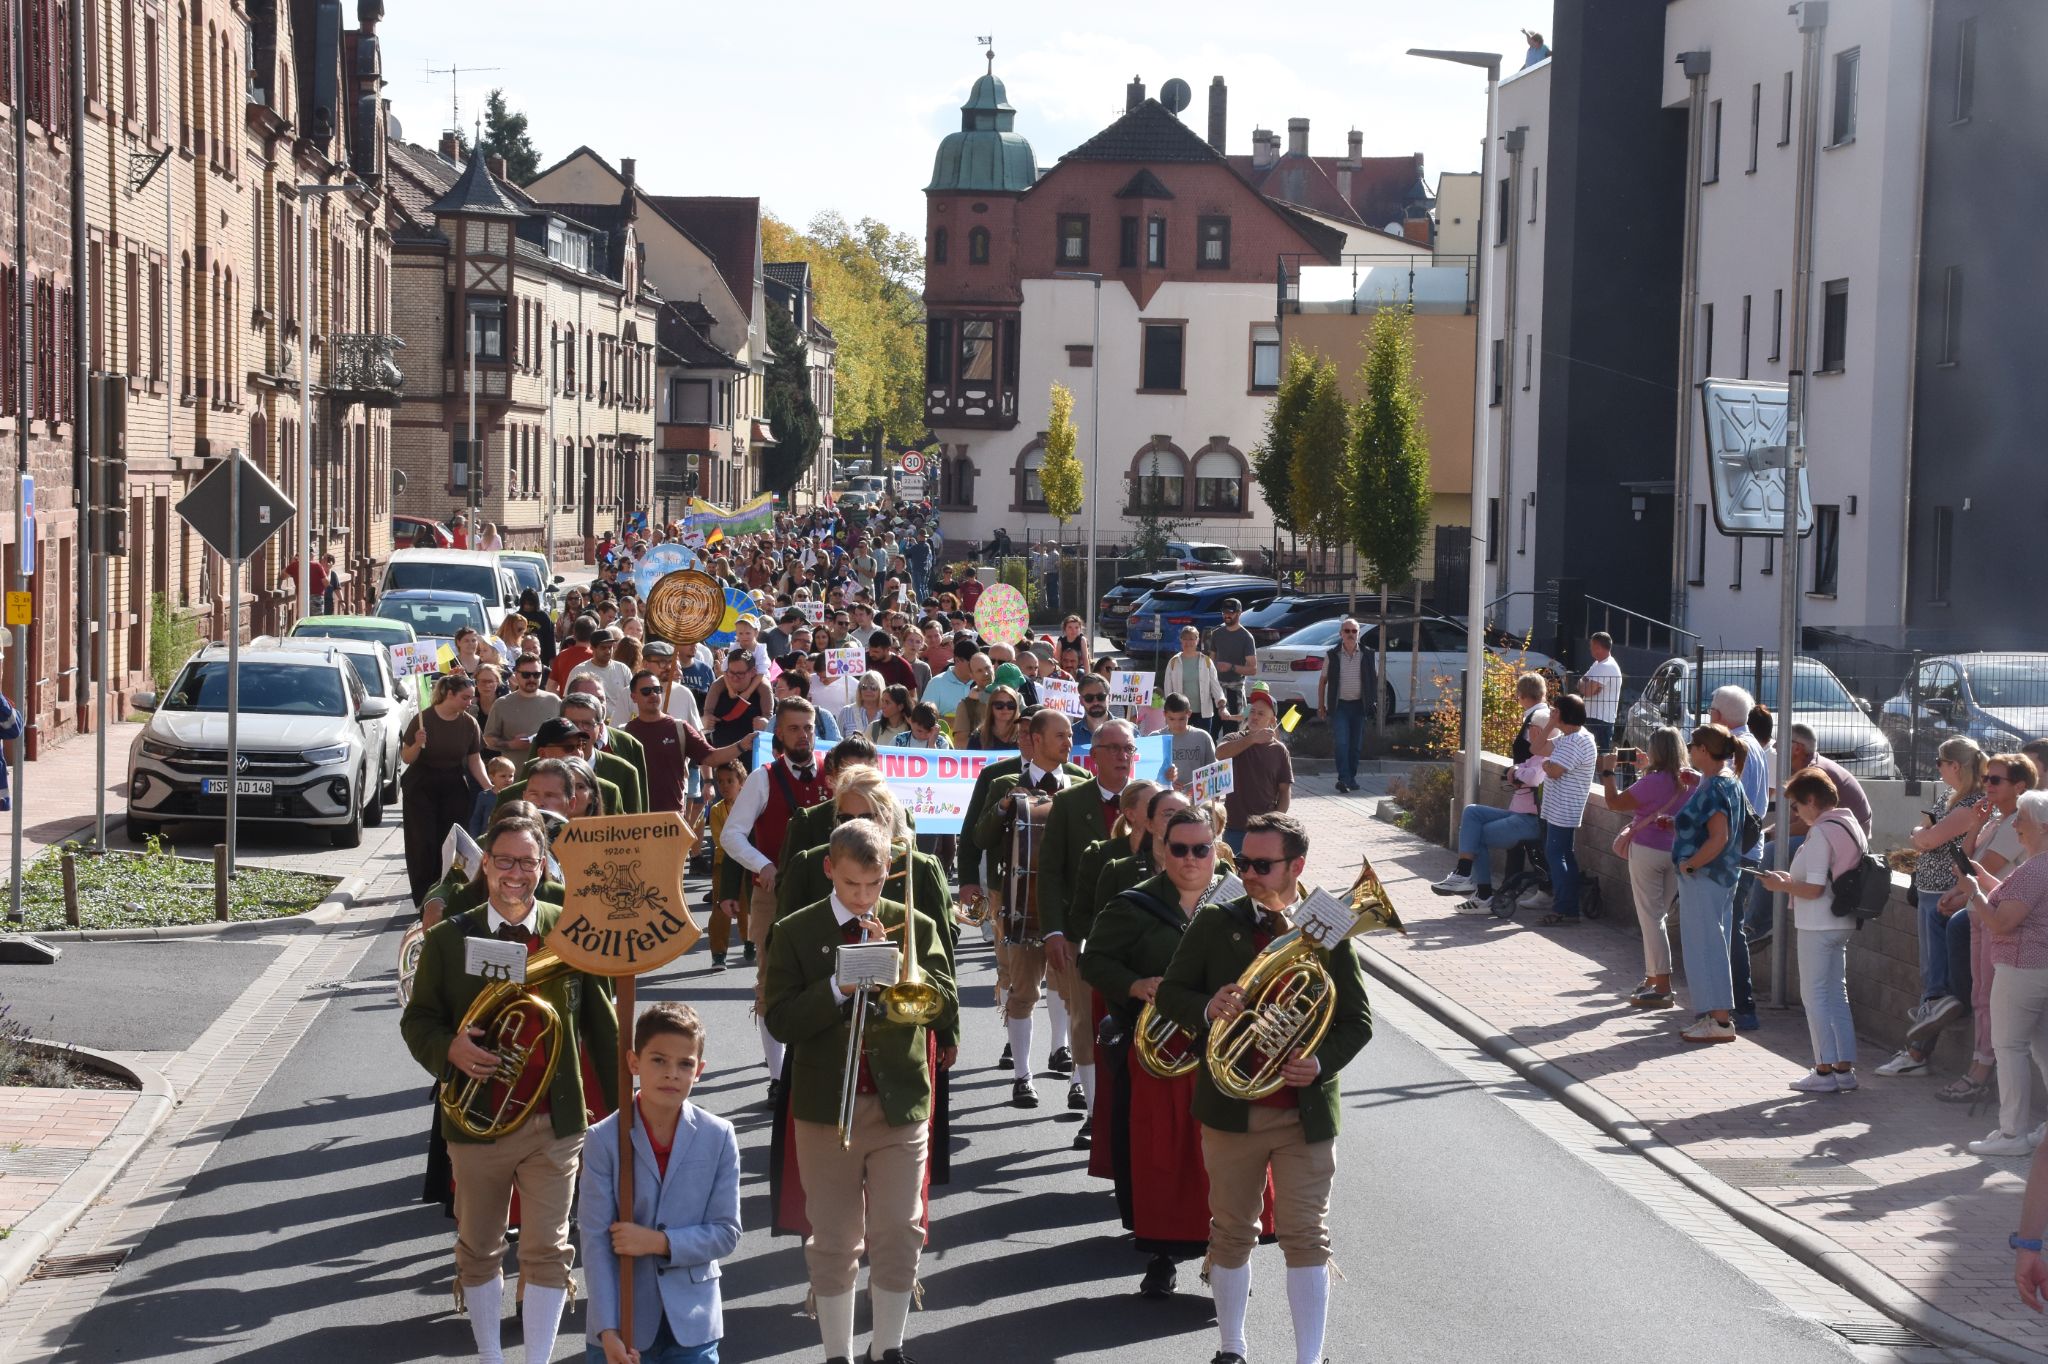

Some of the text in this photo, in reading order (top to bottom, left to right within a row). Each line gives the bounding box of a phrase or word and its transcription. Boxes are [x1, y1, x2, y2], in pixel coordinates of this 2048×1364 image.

[906, 457, 920, 468] 30
[395, 646, 414, 657] WIR
[828, 650, 846, 659] WIR
[406, 654, 428, 665] SIND
[400, 661, 437, 676] STARK
[1045, 680, 1078, 694] WIR SIN
[1043, 697, 1083, 716] SCHNELL
[1195, 769, 1209, 781] WIR
[236, 782, 250, 793] AD
[252, 783, 271, 793] 148
[1195, 774, 1232, 801] SCHLAU
[563, 821, 680, 844] Musikverein
[604, 847, 624, 856] 1920
[561, 909, 686, 963] Röllfeld
